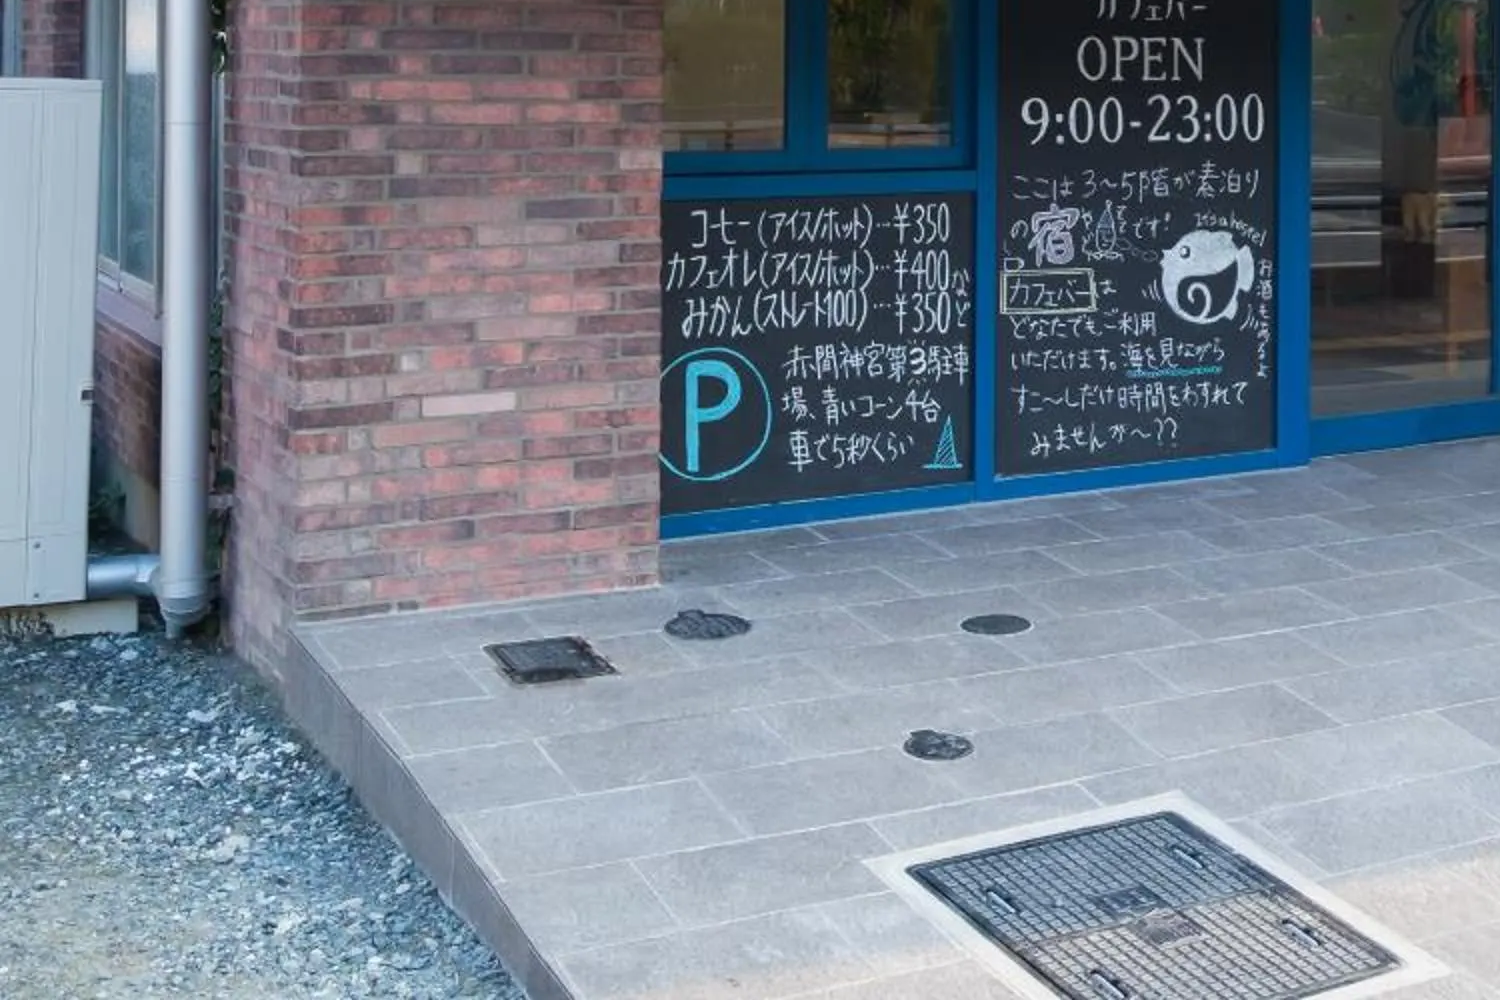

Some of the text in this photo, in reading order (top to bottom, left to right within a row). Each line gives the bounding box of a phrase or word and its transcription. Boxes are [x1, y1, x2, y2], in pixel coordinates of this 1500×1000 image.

[1076, 34, 1206, 83] OPEN
[1020, 92, 1266, 147] 9:00-23:00
[685, 358, 743, 474] P
